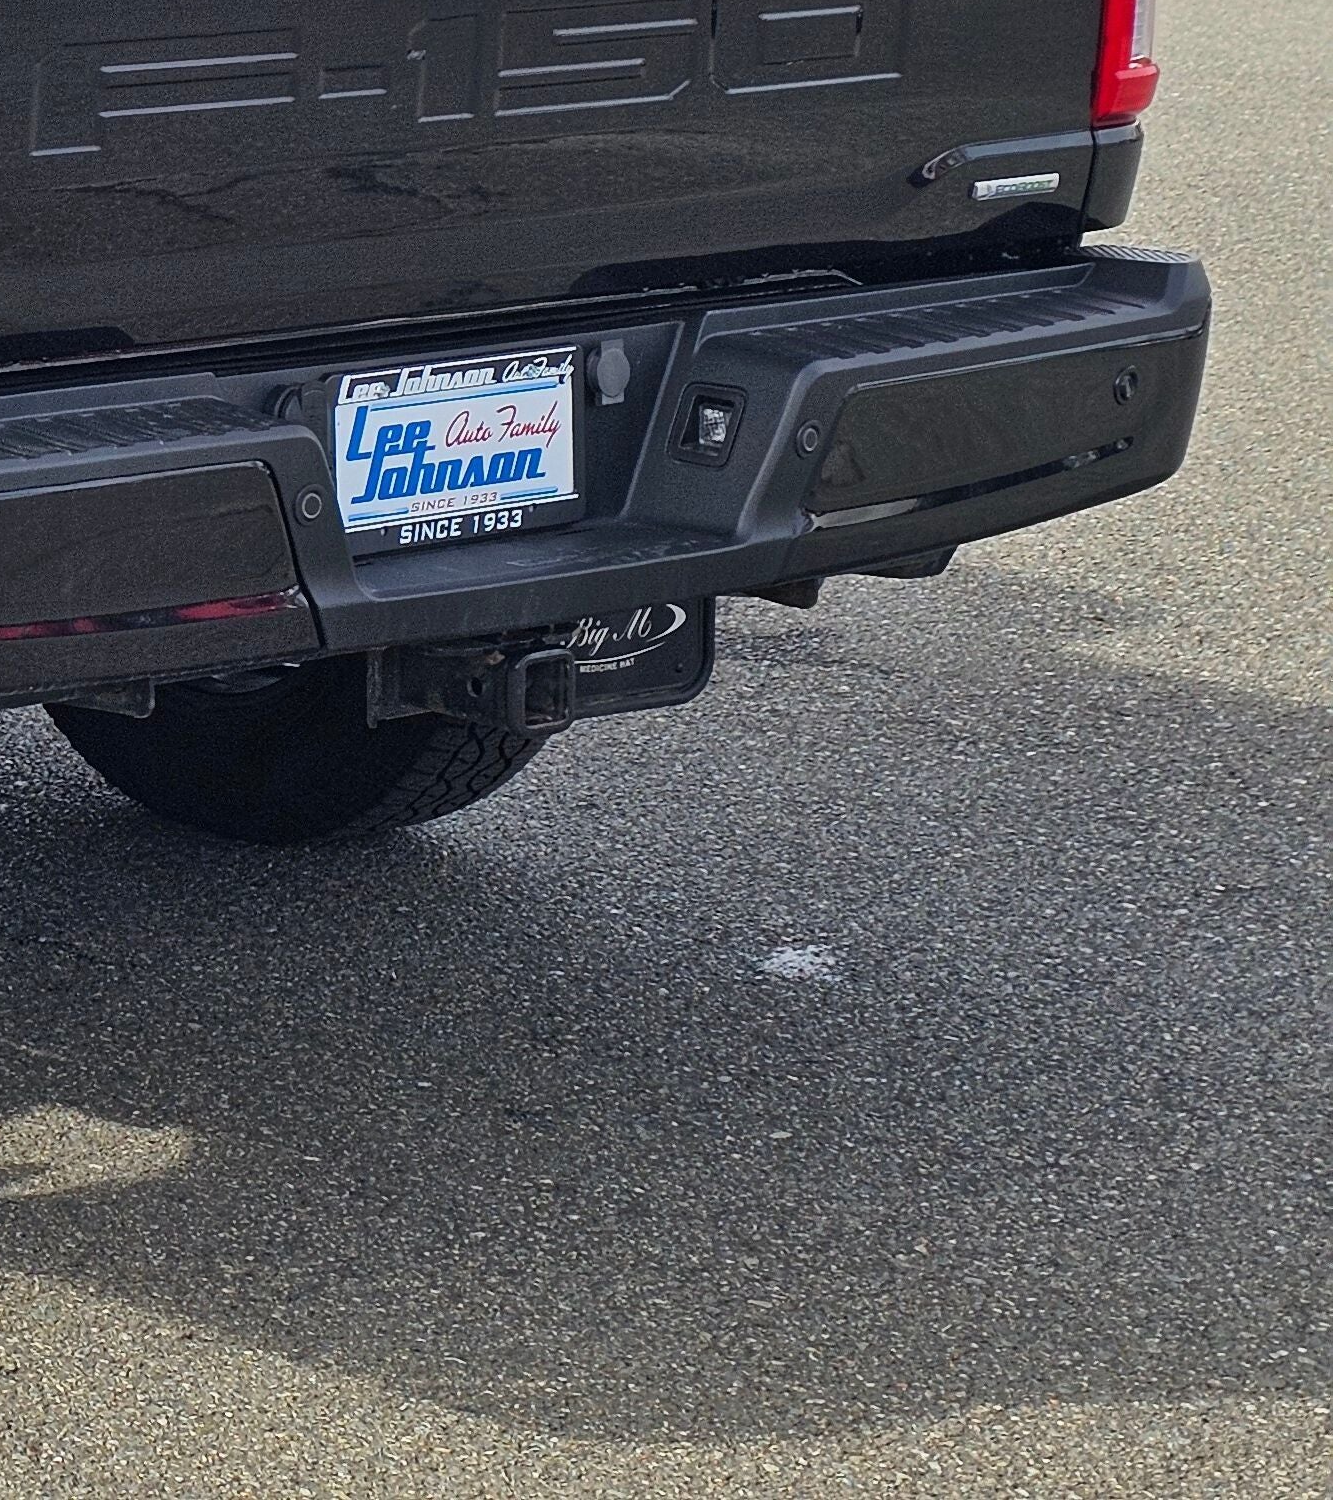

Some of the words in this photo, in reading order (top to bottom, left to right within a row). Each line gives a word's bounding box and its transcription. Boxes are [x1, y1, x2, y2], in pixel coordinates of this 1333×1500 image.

[337, 376, 391, 405] Lee
[390, 365, 497, 397] Johnson
[346, 405, 436, 462] Lee
[445, 410, 493, 448] Auto
[496, 400, 562, 448] Family
[350, 435, 546, 505] Johnson
[410, 498, 455, 513] SINCE
[463, 491, 498, 505] 1933
[399, 517, 464, 544] SINCE
[471, 509, 523, 534] 1933
[559, 616, 610, 657] Big
[612, 606, 653, 642] M
[579, 662, 618, 673] MEDICINE
